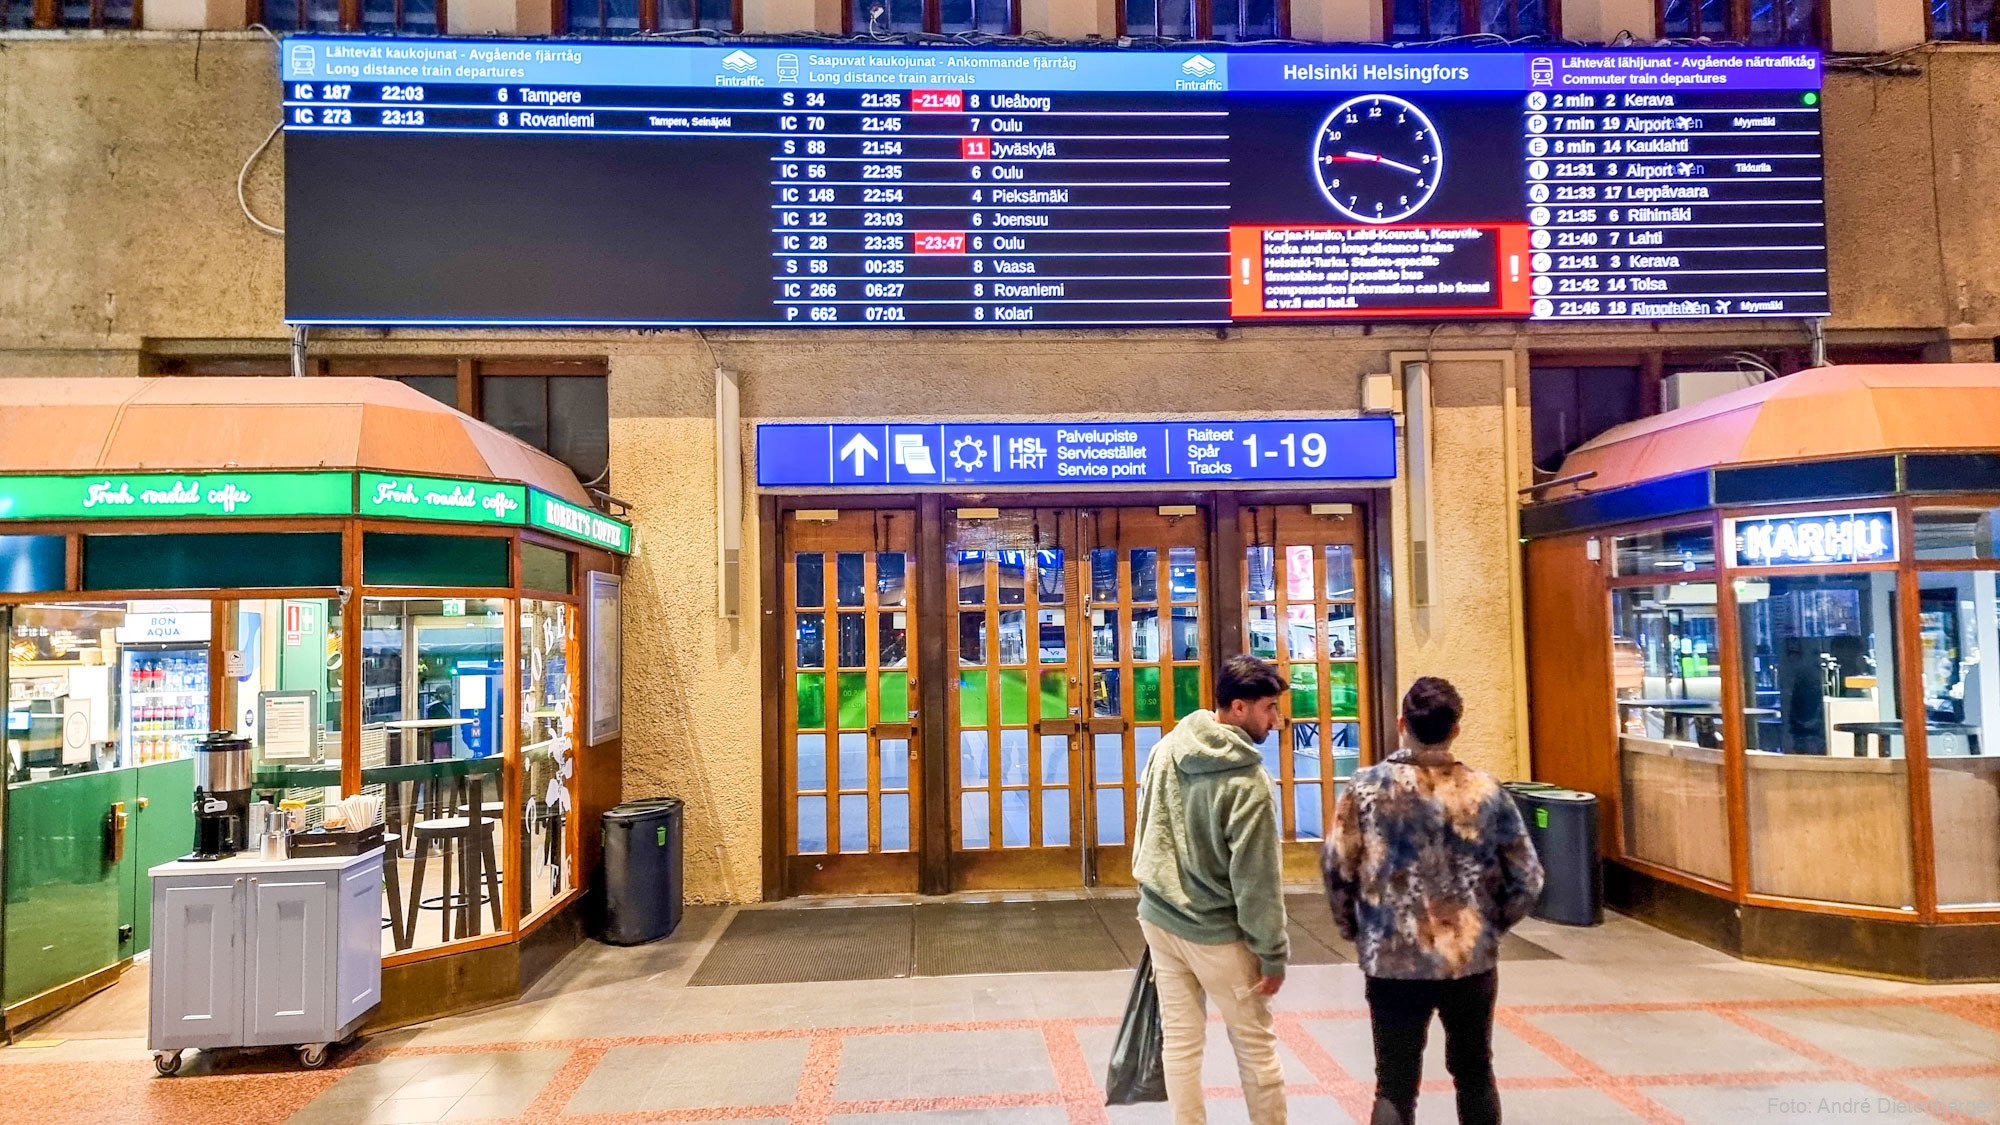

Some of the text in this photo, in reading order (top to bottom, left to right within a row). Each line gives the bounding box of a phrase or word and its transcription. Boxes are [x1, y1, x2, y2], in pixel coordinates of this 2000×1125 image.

[326, 46, 582, 64] Lähtevät kaukojunat Avgående fjärrtåg
[809, 55, 1076, 72] Saapuvat kaukojunat Ankommande fjärrtåg
[1562, 56, 1816, 70] Lähtevät lähijunat Avgående närtrafiktåg
[326, 64, 524, 79] Long distance train departures
[1284, 64, 1469, 84] Helsinki Helsingfors
[715, 75, 764, 87] Fintraffic
[809, 72, 975, 86] Long distance train arrivals
[1175, 79, 1222, 91] Fintraffic
[1562, 74, 1726, 85] Commuter train departures
[295, 85, 581, 105] IC 187 22:03 6 Tampere
[783, 93, 1051, 111] S 34 21:35 ~21:40 8 Uleåborg
[1532, 94, 1673, 107] K 2 min 2 Kerava
[296, 109, 594, 127] IC 273 23:13 8 Rovaniemi
[649, 116, 689, 128] Tampere,
[781, 117, 1022, 132] IC 70 21:45 7 Oulu
[1554, 118, 1563, 130] 7
[1568, 118, 1594, 130] min
[1603, 118, 1620, 130] 19
[784, 140, 1056, 158] S 88 21:54 11 Jyväskylä
[1555, 138, 1688, 153] 8 min 14 Kauklahti
[782, 164, 1023, 179] IC 56 22:35 6 Oulu
[1556, 164, 1595, 176] 21:31
[1608, 164, 1617, 176] 3
[783, 189, 1068, 203] IC 148 22:54 4 Pieksämäki
[1556, 186, 1708, 201] 21:33 17 Leppävaara
[784, 212, 1048, 226] IC 12 23:03 6 Joensuu
[1557, 208, 1691, 222] 21:35 6 Riihimäki
[784, 236, 1025, 250] IC 28 23:35 ~23:47 6 Oulu
[1558, 232, 1662, 245] 21:40 7 Lahti
[1342, 243, 1419, 256] long-distance
[787, 260, 1035, 274] S 58 00:35 8 Vaasa
[1559, 255, 1679, 268] 21:41 3 Kerava
[785, 284, 1064, 298] IC 266 06:27 8 Rovaniemi
[1265, 284, 1346, 296] compensation
[1559, 278, 1667, 291] 21:42 14 Tolsa
[1302, 297, 1324, 308] and
[1608, 302, 1626, 314] 18
[788, 307, 1033, 321] P 662 07:01 8 Kolari
[1057, 430, 1137, 446] Palvelupiste
[1187, 429, 1233, 442] Raiteet
[1009, 439, 1047, 454] HSL
[1188, 443, 1219, 460] Spår
[1242, 433, 1327, 468] 1-19
[1057, 446, 1146, 462] Servicestället
[1010, 454, 1047, 470] HRT
[1188, 460, 1232, 475] Tracks
[1057, 462, 1146, 478] Service point
[84, 481, 250, 511] Fresh roasted coffee
[373, 481, 517, 516] Fresh roasted coffee
[546, 501, 621, 548] ROBERT'S COFFEE
[1747, 518, 1884, 558] KARHU
[151, 616, 177, 626] BON
[146, 627, 180, 636] AQUA
